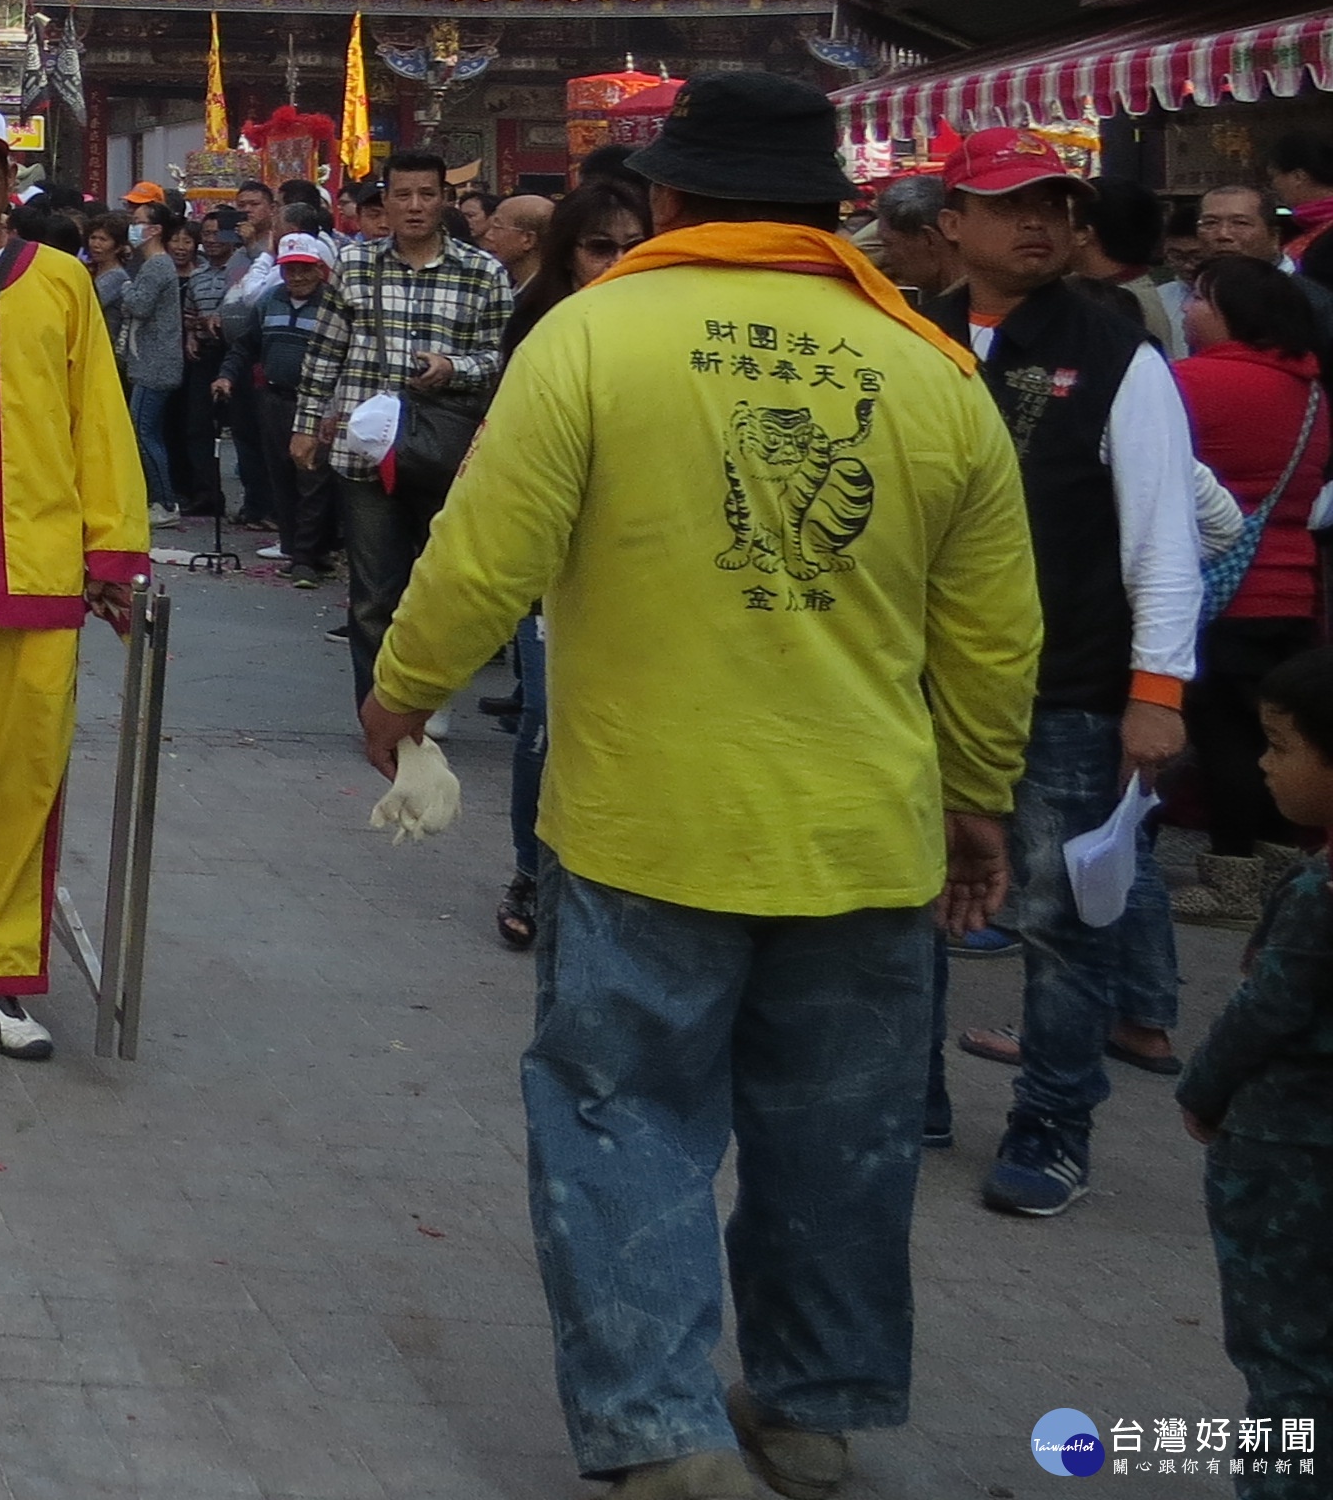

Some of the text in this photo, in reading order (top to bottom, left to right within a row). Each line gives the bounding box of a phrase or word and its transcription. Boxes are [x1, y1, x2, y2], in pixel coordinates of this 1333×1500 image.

[704, 319, 865, 358] 財團法人
[690, 349, 886, 393] 新港奉天宮
